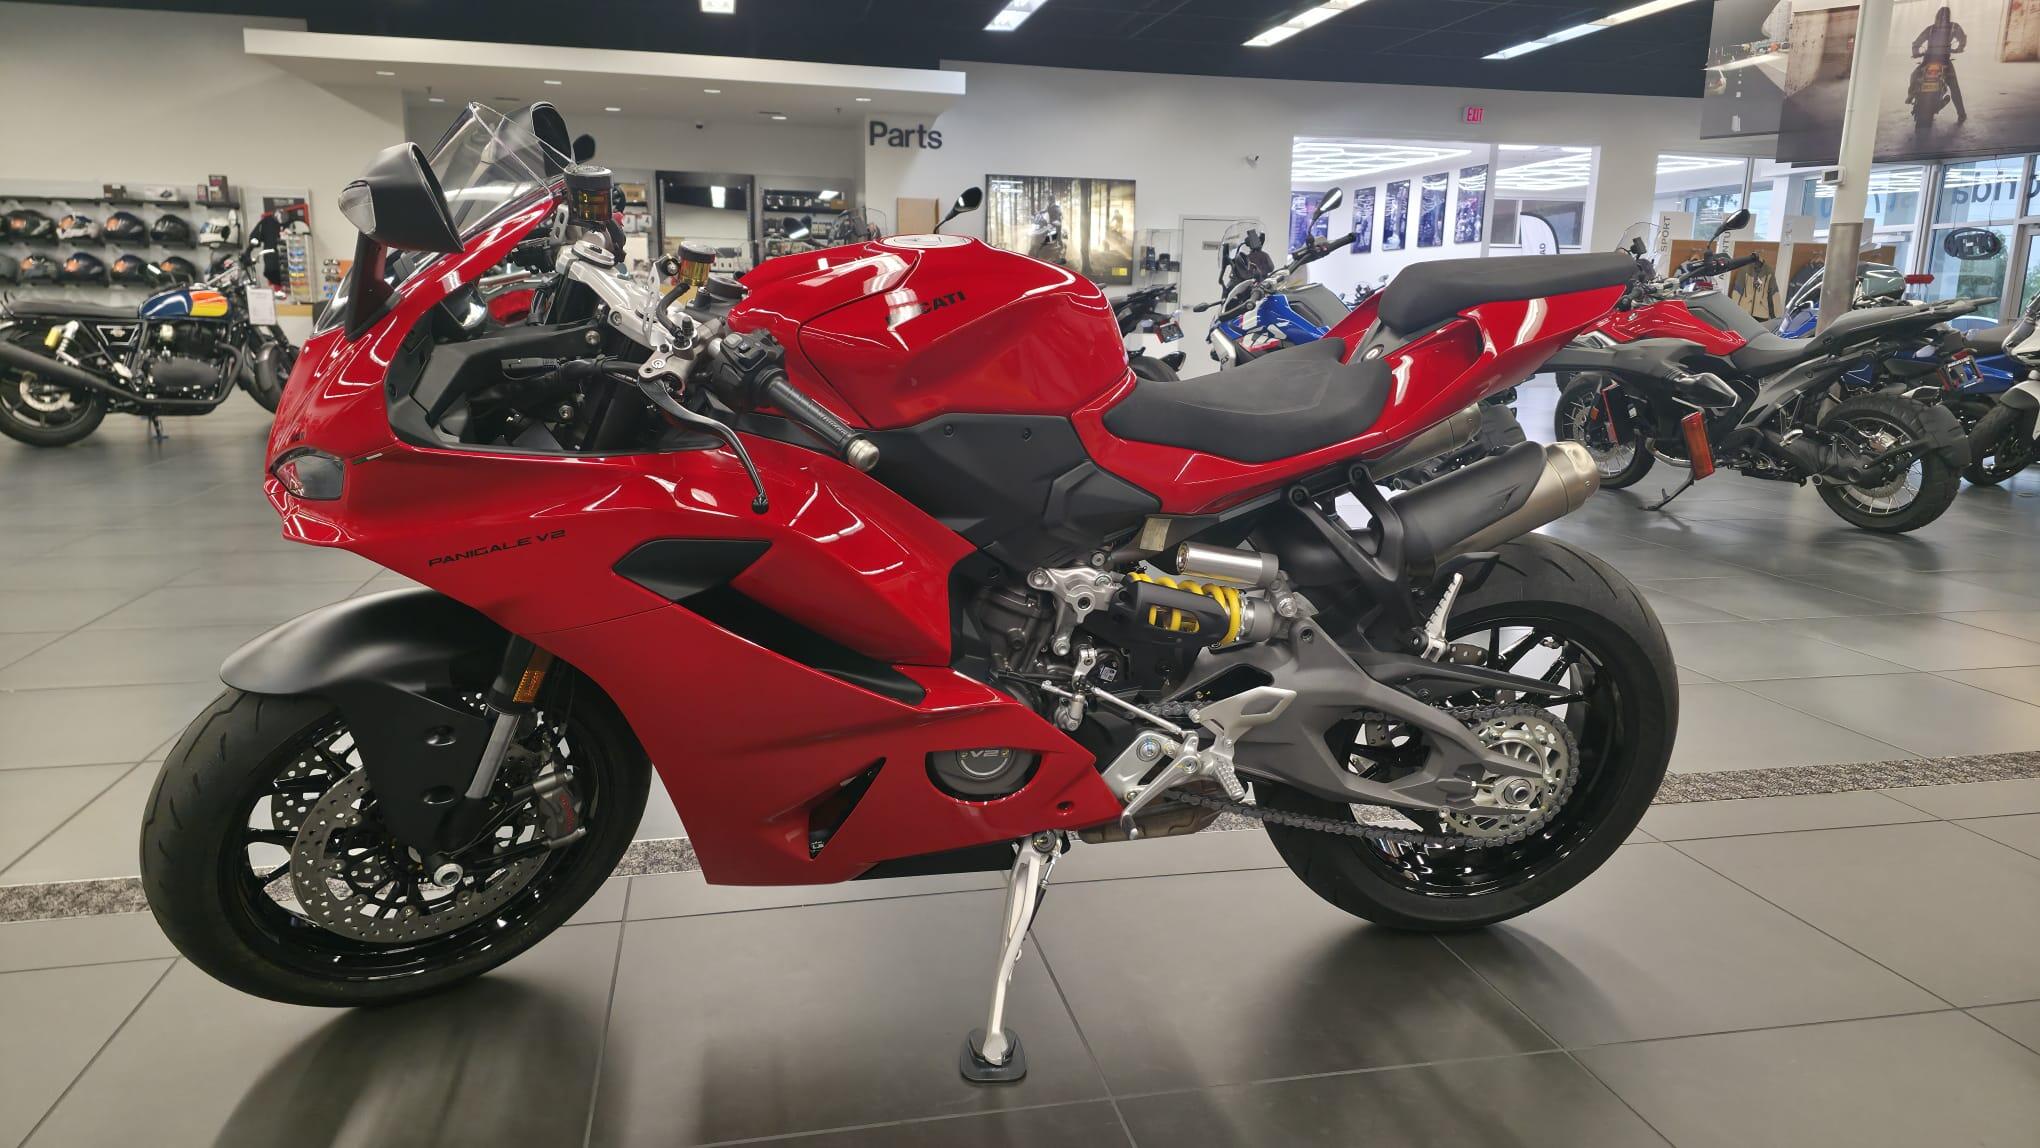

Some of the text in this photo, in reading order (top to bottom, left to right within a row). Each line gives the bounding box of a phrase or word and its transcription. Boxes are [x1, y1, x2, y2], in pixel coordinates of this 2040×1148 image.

[1466, 107, 1485, 122] EXIT
[869, 121, 943, 150] Parts
[1661, 215, 1671, 252] SPORT
[428, 529, 566, 567] PANIGALE V2
[970, 749, 999, 758] V2
